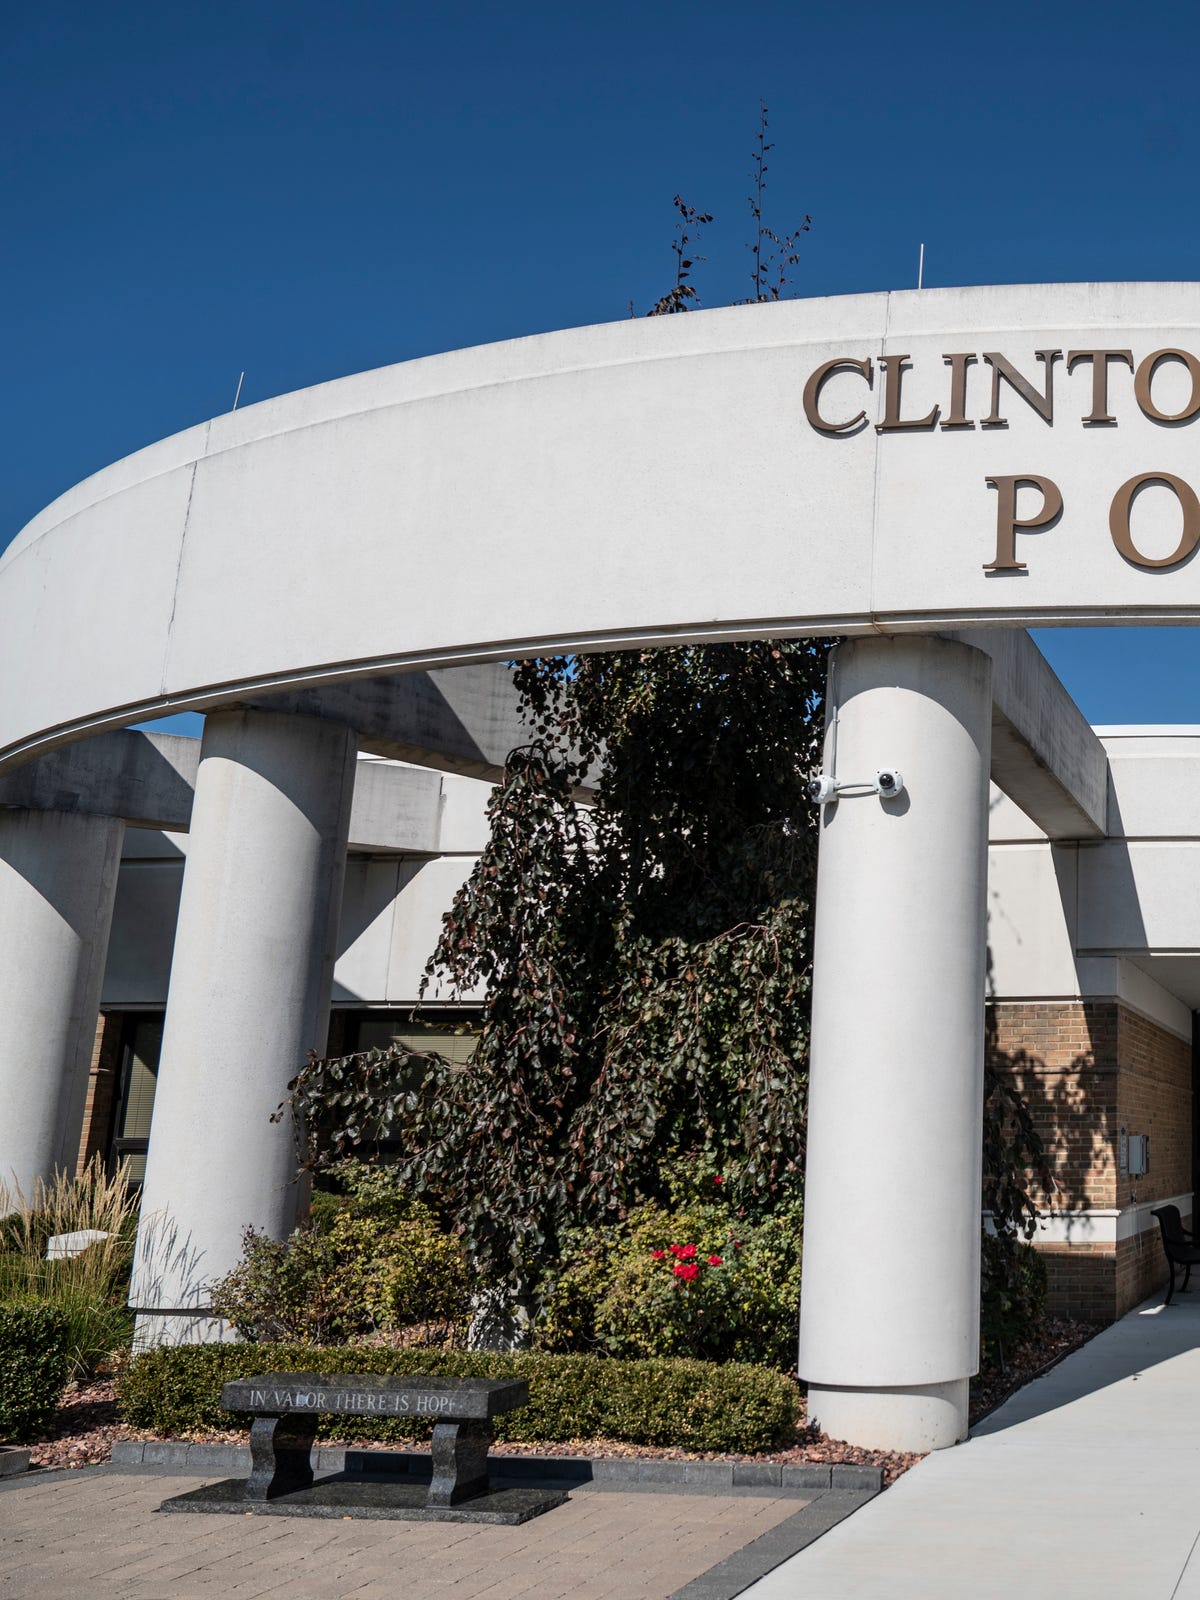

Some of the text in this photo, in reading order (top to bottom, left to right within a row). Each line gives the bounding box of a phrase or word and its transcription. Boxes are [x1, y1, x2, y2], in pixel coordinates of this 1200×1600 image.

[249, 1390, 267, 1406] IN
[275, 1391, 325, 1408] VALOR
[335, 1393, 386, 1410] THERE
[395, 1395, 409, 1410] IS
